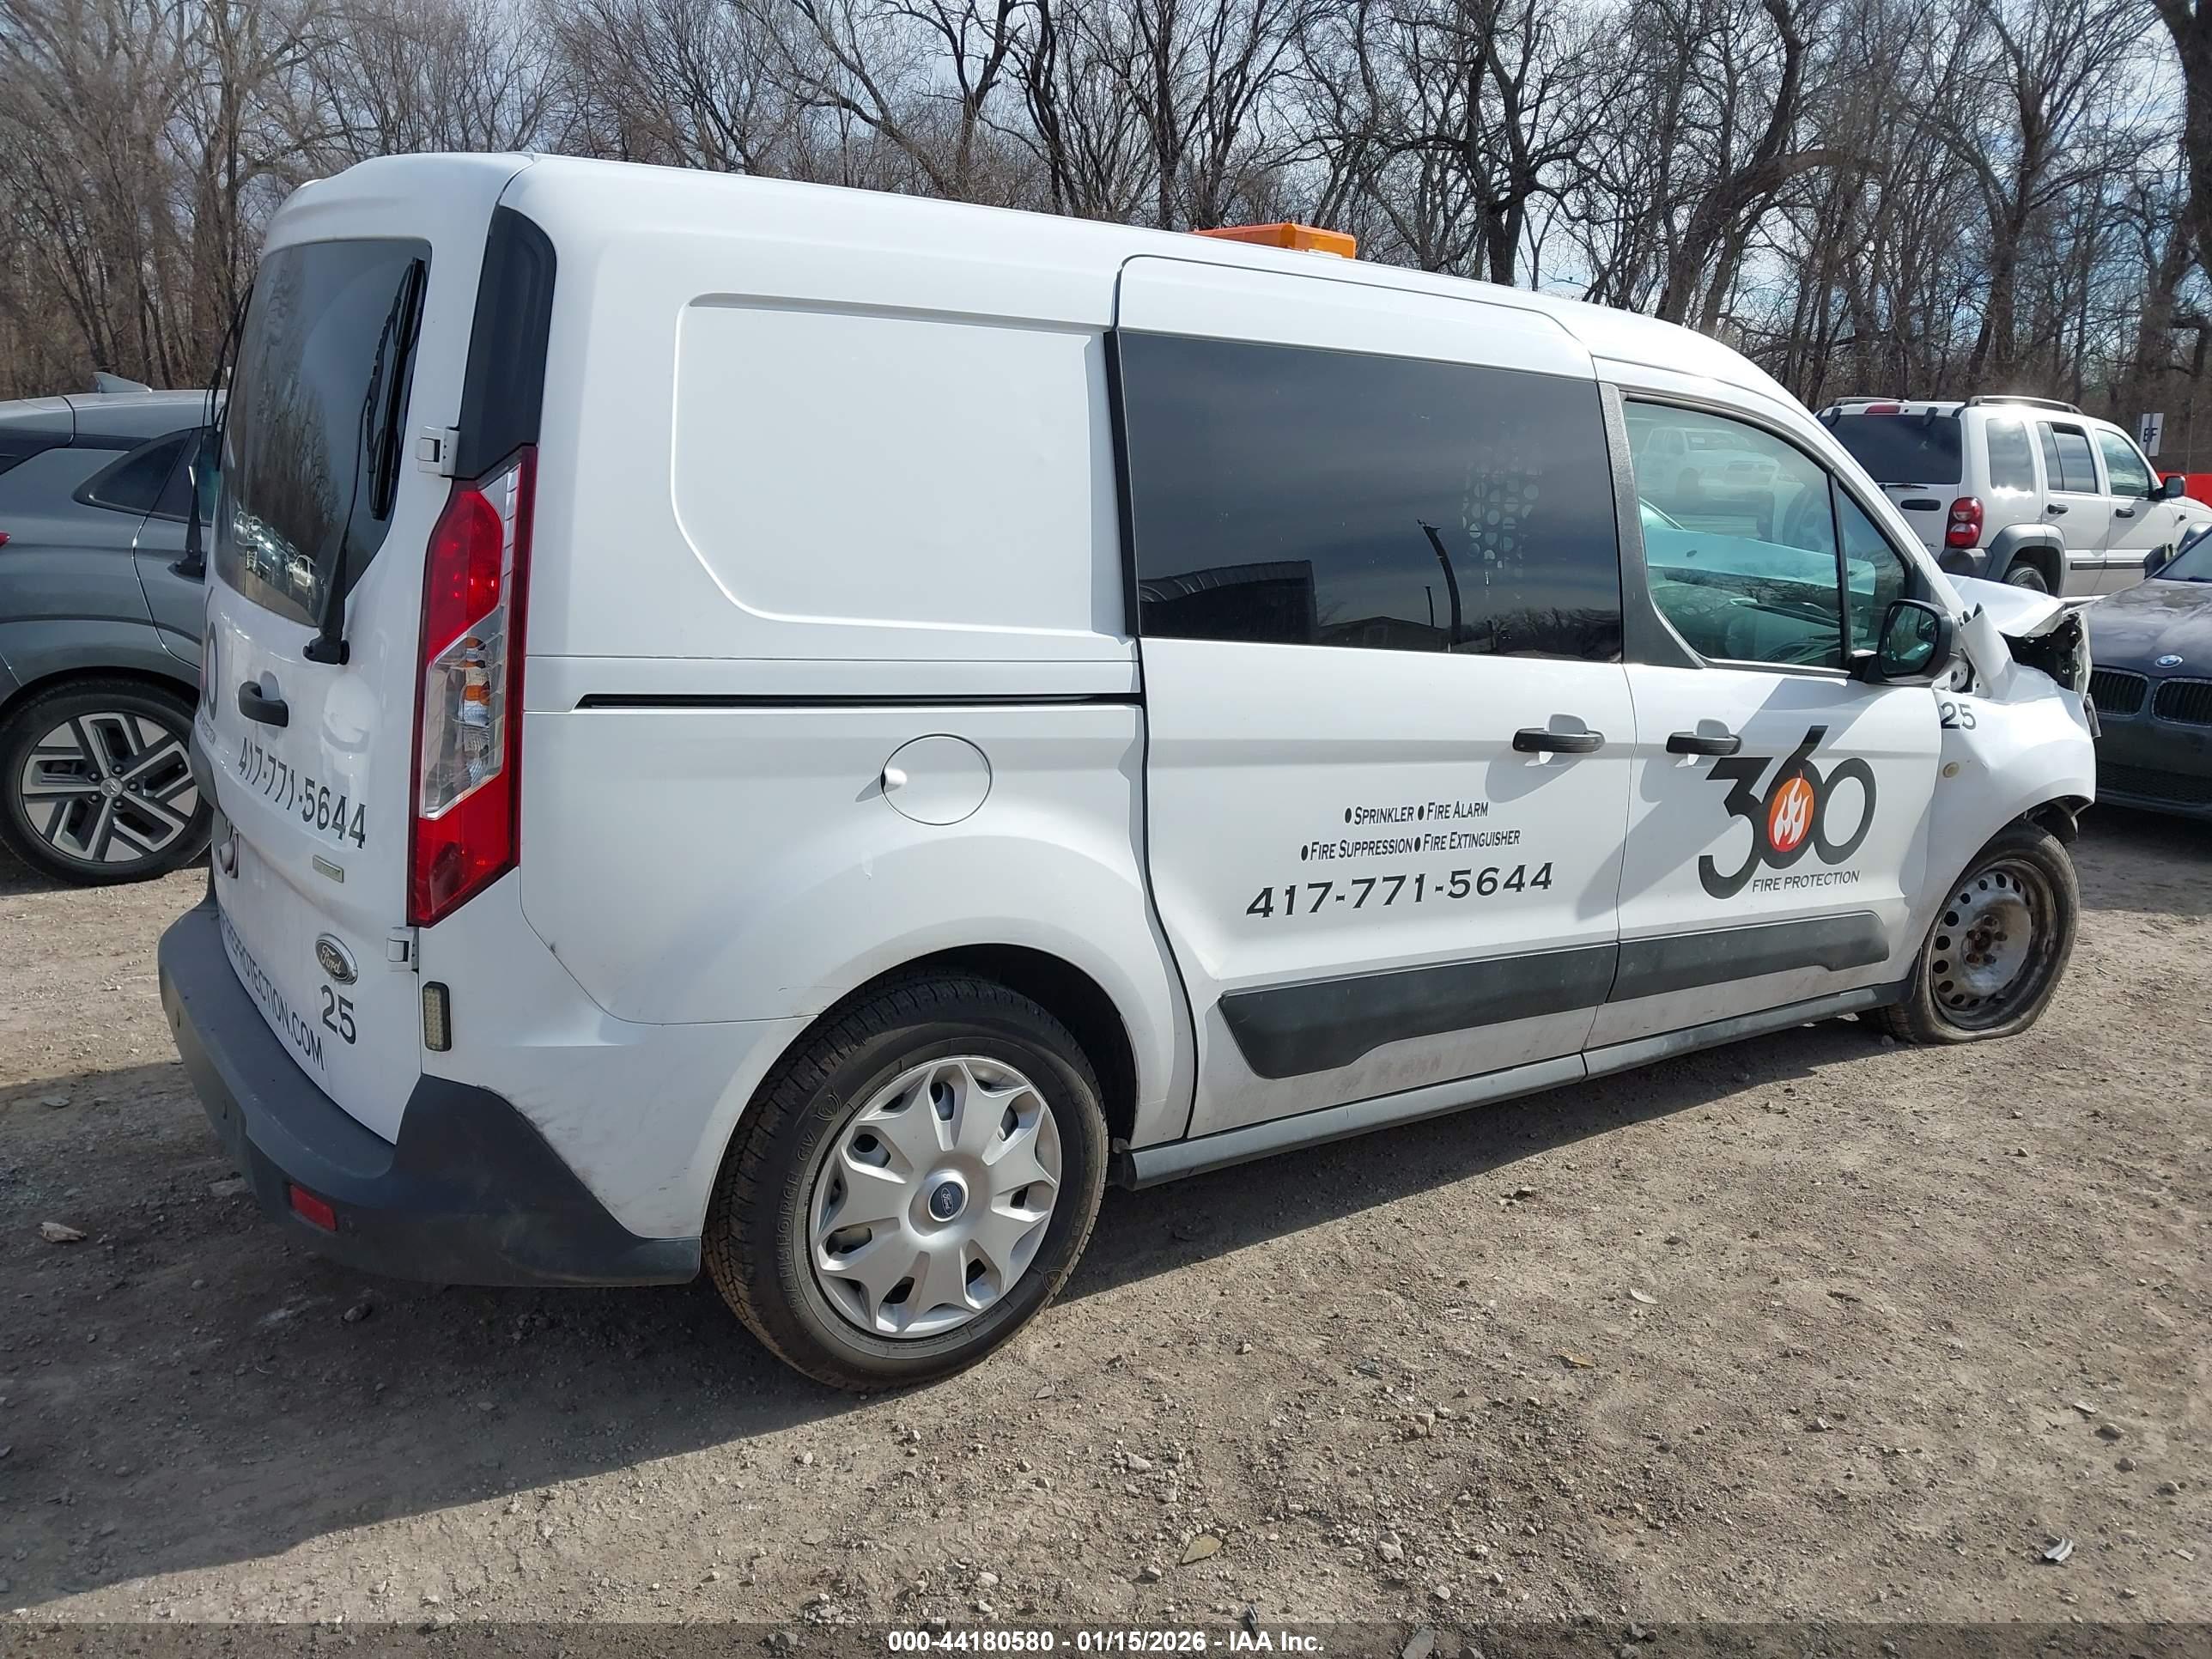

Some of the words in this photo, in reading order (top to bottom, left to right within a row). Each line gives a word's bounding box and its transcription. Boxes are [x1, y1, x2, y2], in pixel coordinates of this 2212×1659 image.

[1941, 701, 1977, 730] 25
[238, 736, 367, 850] 417-771-5644
[1353, 805, 1415, 825] SPRINKLER
[1426, 801, 1452, 821] FIRE
[1453, 800, 1489, 818] ALARM
[1698, 725, 1877, 900] 360
[1310, 841, 1336, 860] FIRE
[1338, 838, 1414, 859] SUPPRESSION
[1422, 833, 1448, 852] FIRE
[1449, 829, 1521, 850] EXTINGUISHER
[1245, 861, 1554, 919] 417-771-5644
[1751, 877, 1782, 893] FIRE
[1784, 870, 1861, 890] PROTECTION
[320, 984, 357, 1045] 25
